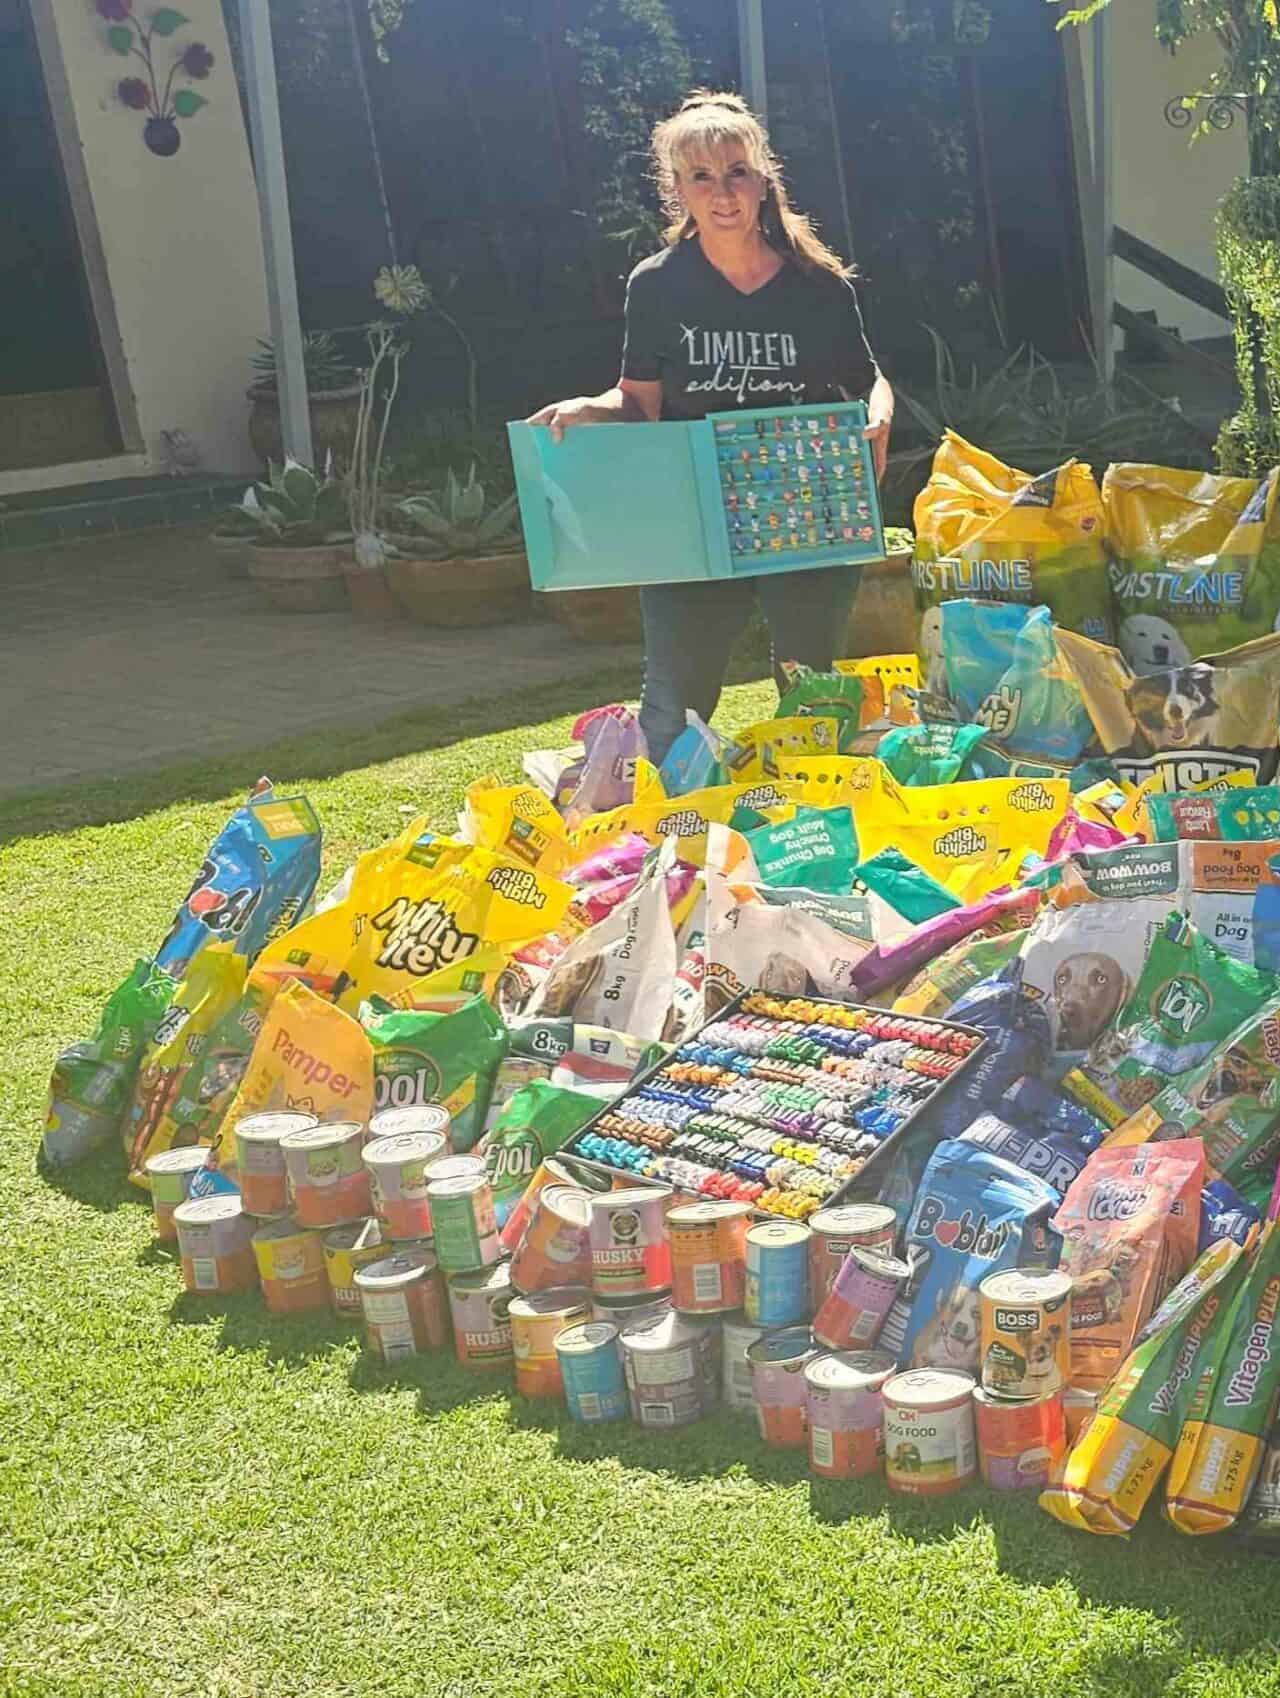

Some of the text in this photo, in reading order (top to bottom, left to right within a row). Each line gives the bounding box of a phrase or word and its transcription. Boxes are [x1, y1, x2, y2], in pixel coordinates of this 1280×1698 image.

[688, 331, 797, 367] LIMITED
[685, 356, 806, 404] edition
[1007, 789, 1056, 813] Mighty
[934, 836, 986, 858] Mighty
[496, 867, 536, 890] Bite
[1096, 859, 1172, 878] BOWWOW
[1193, 861, 1250, 875] Dog Food
[487, 869, 547, 909] Mighty
[1214, 923, 1249, 941] Dog
[605, 974, 626, 1001] 8kg
[533, 1031, 568, 1053] 8kg
[272, 1027, 360, 1098] Pamper
[592, 1248, 644, 1265] HUSKY
[1258, 1278, 1280, 1323] PLUS
[998, 1312, 1038, 1326] BOSS
[1224, 1322, 1272, 1407] Vitagen
[905, 1427, 937, 1438] FOOD
